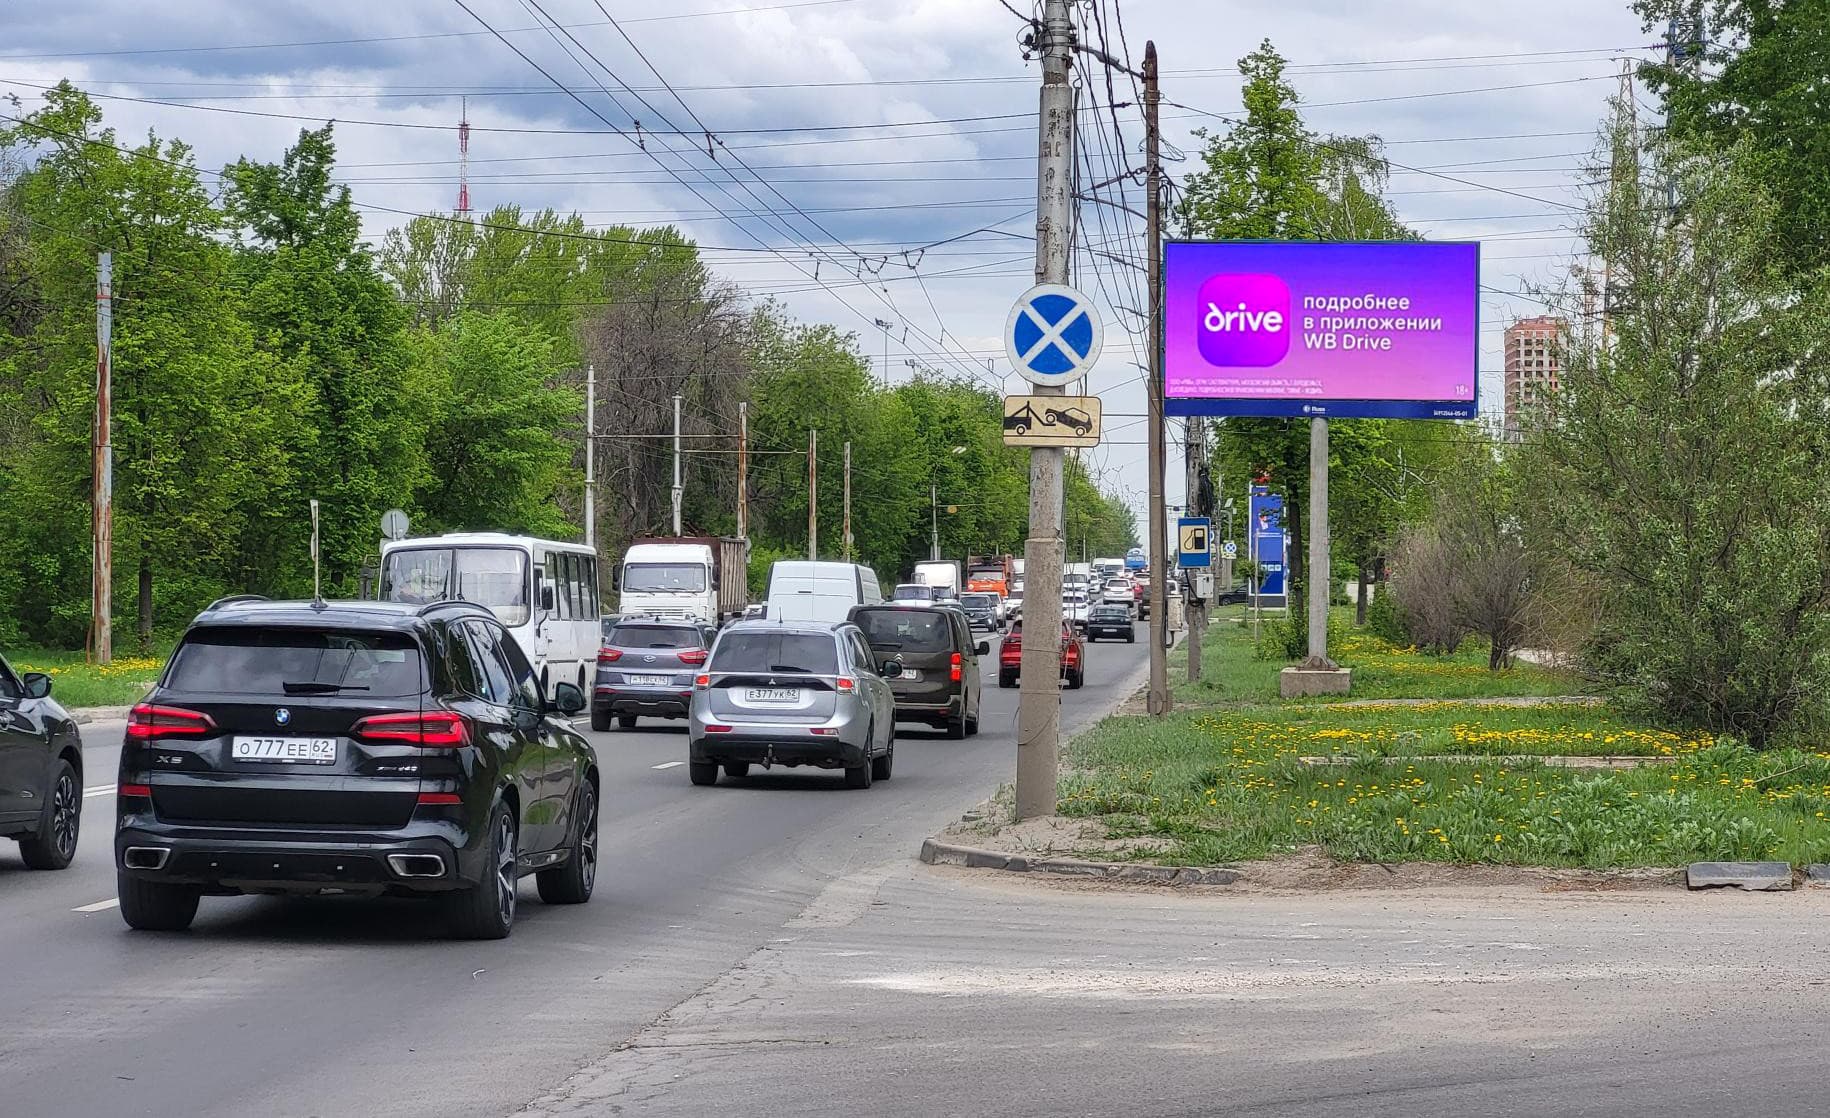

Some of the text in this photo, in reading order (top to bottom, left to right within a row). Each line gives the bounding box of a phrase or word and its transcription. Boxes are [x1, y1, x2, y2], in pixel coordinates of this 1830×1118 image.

[1303, 294, 1410, 313] подробнее
[1204, 302, 1283, 332] drive
[1303, 316, 1442, 332] в приложении
[1303, 333, 1392, 350] WB Drive
[1455, 384, 1469, 396] 18+
[312, 740, 329, 752] 62
